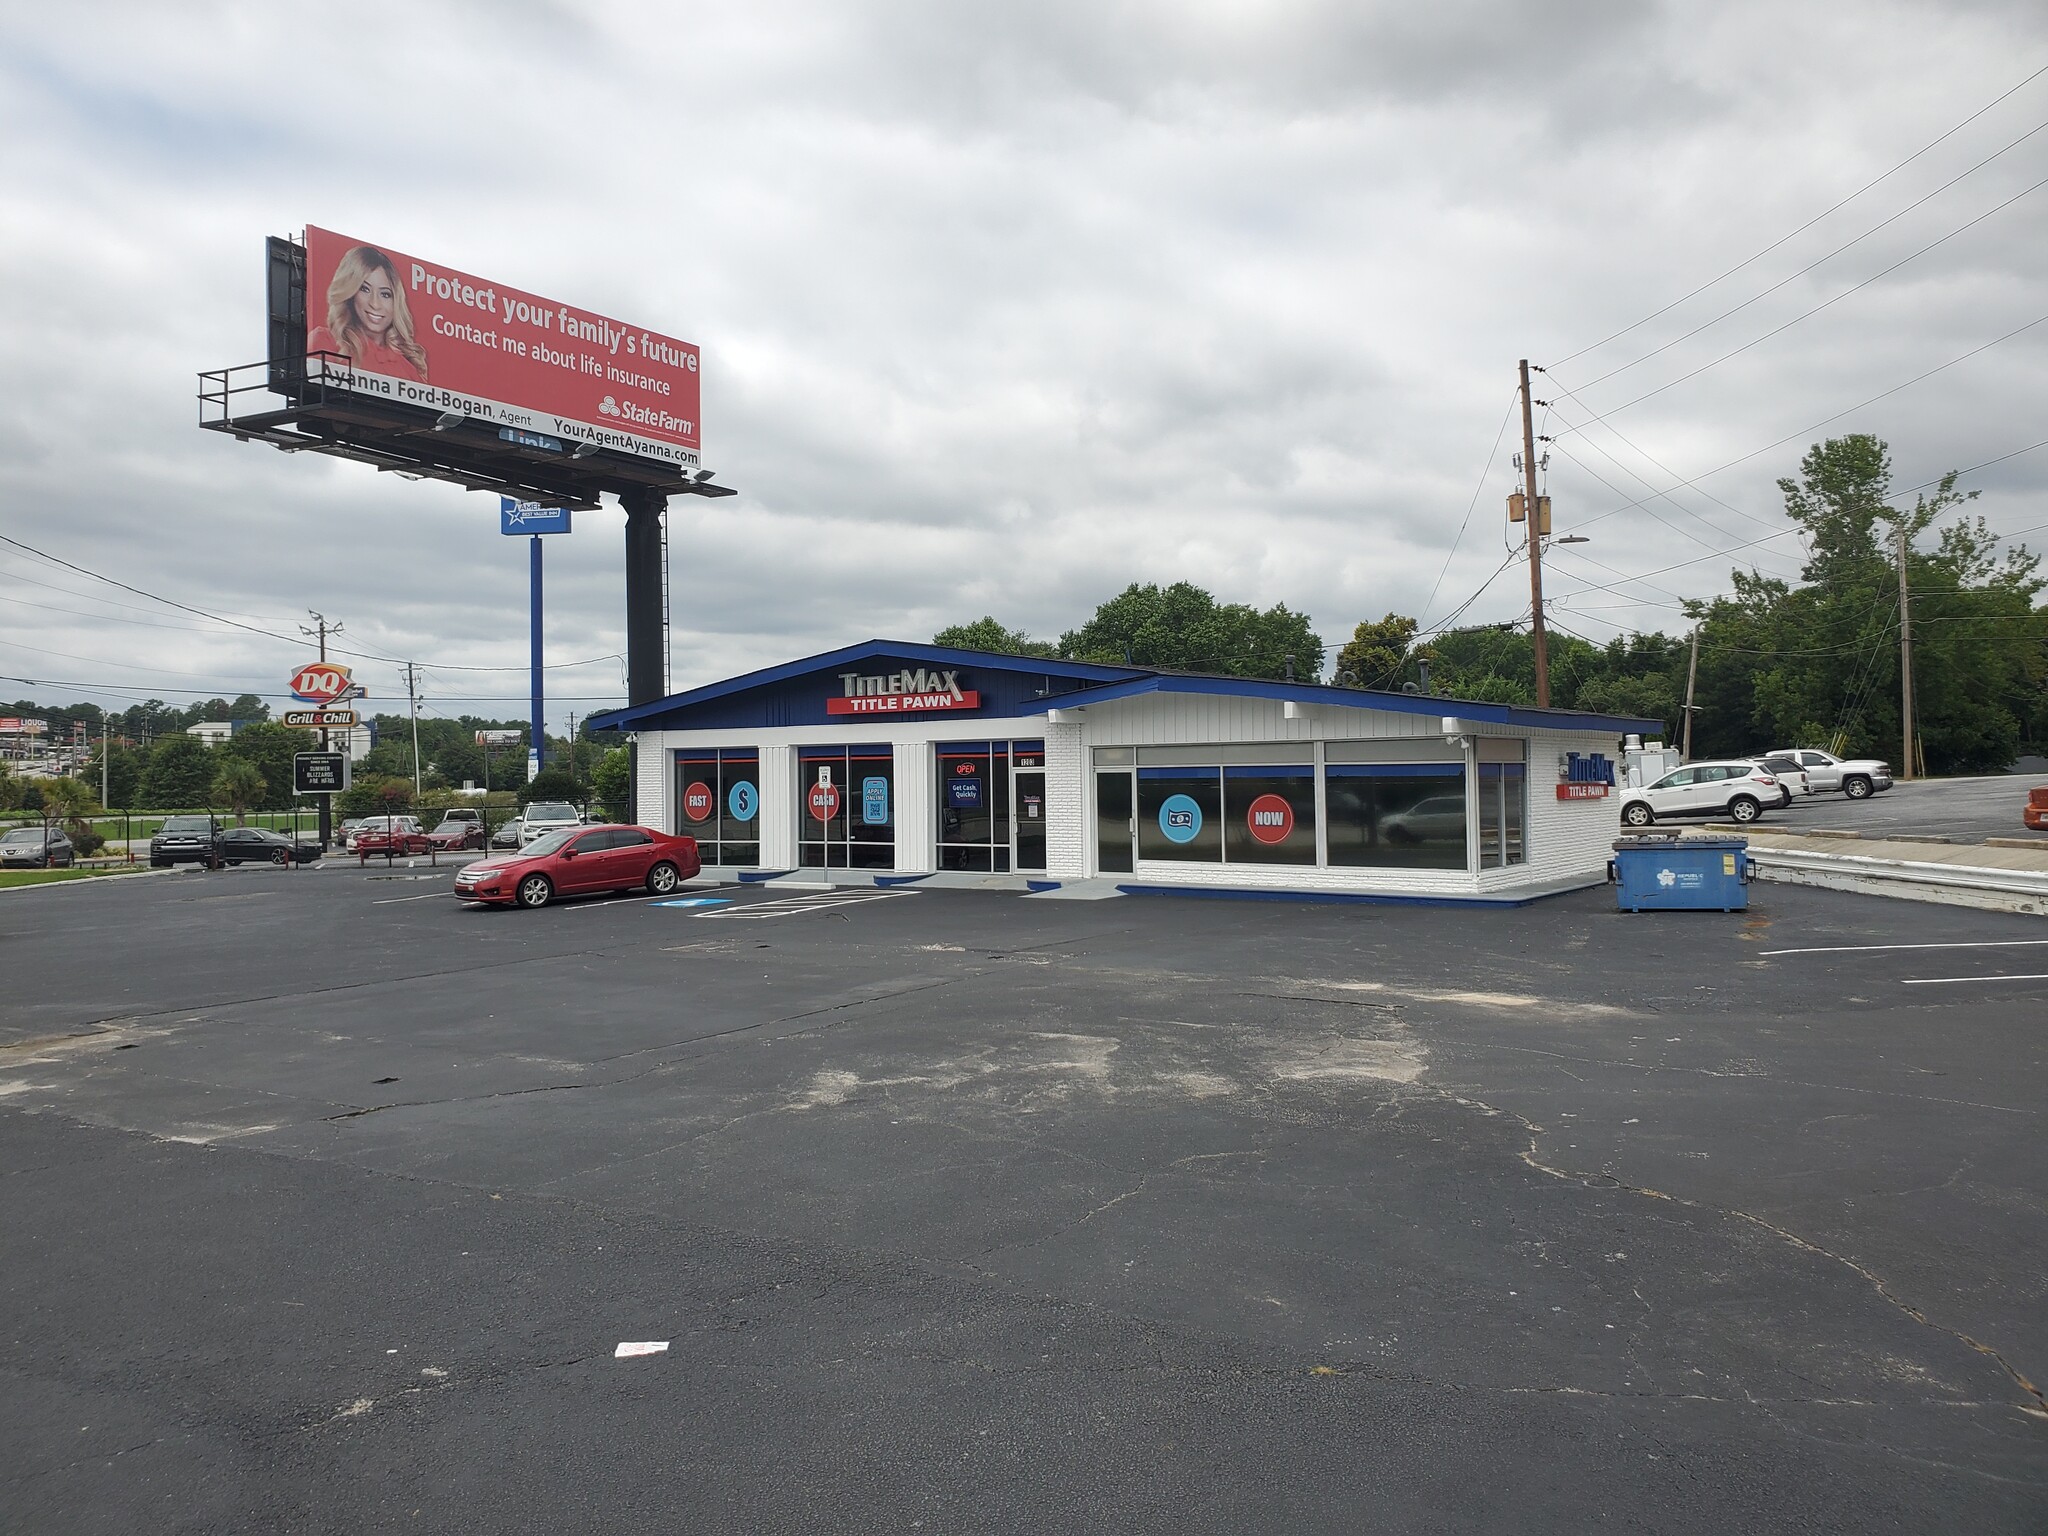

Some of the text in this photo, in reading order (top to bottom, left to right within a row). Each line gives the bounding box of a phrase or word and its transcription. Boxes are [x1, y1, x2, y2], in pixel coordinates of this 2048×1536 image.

[411, 263, 698, 373] Protect your family's future
[432, 314, 671, 396] Contact me about life insurance
[324, 364, 532, 427] Ayanna Ford-Bogan, Agent
[554, 418, 698, 465] YourAgentAyanna.com
[299, 671, 340, 695] DQ
[851, 695, 951, 712] TITLE PAWN
[957, 762, 976, 774] OPEN
[953, 784, 963, 792] Get
[956, 791, 977, 799] Quickly
[1569, 785, 1605, 797] TITLE PAWN
[689, 795, 708, 807] FAST
[813, 795, 835, 806] CASH
[1255, 811, 1284, 826] NOW
